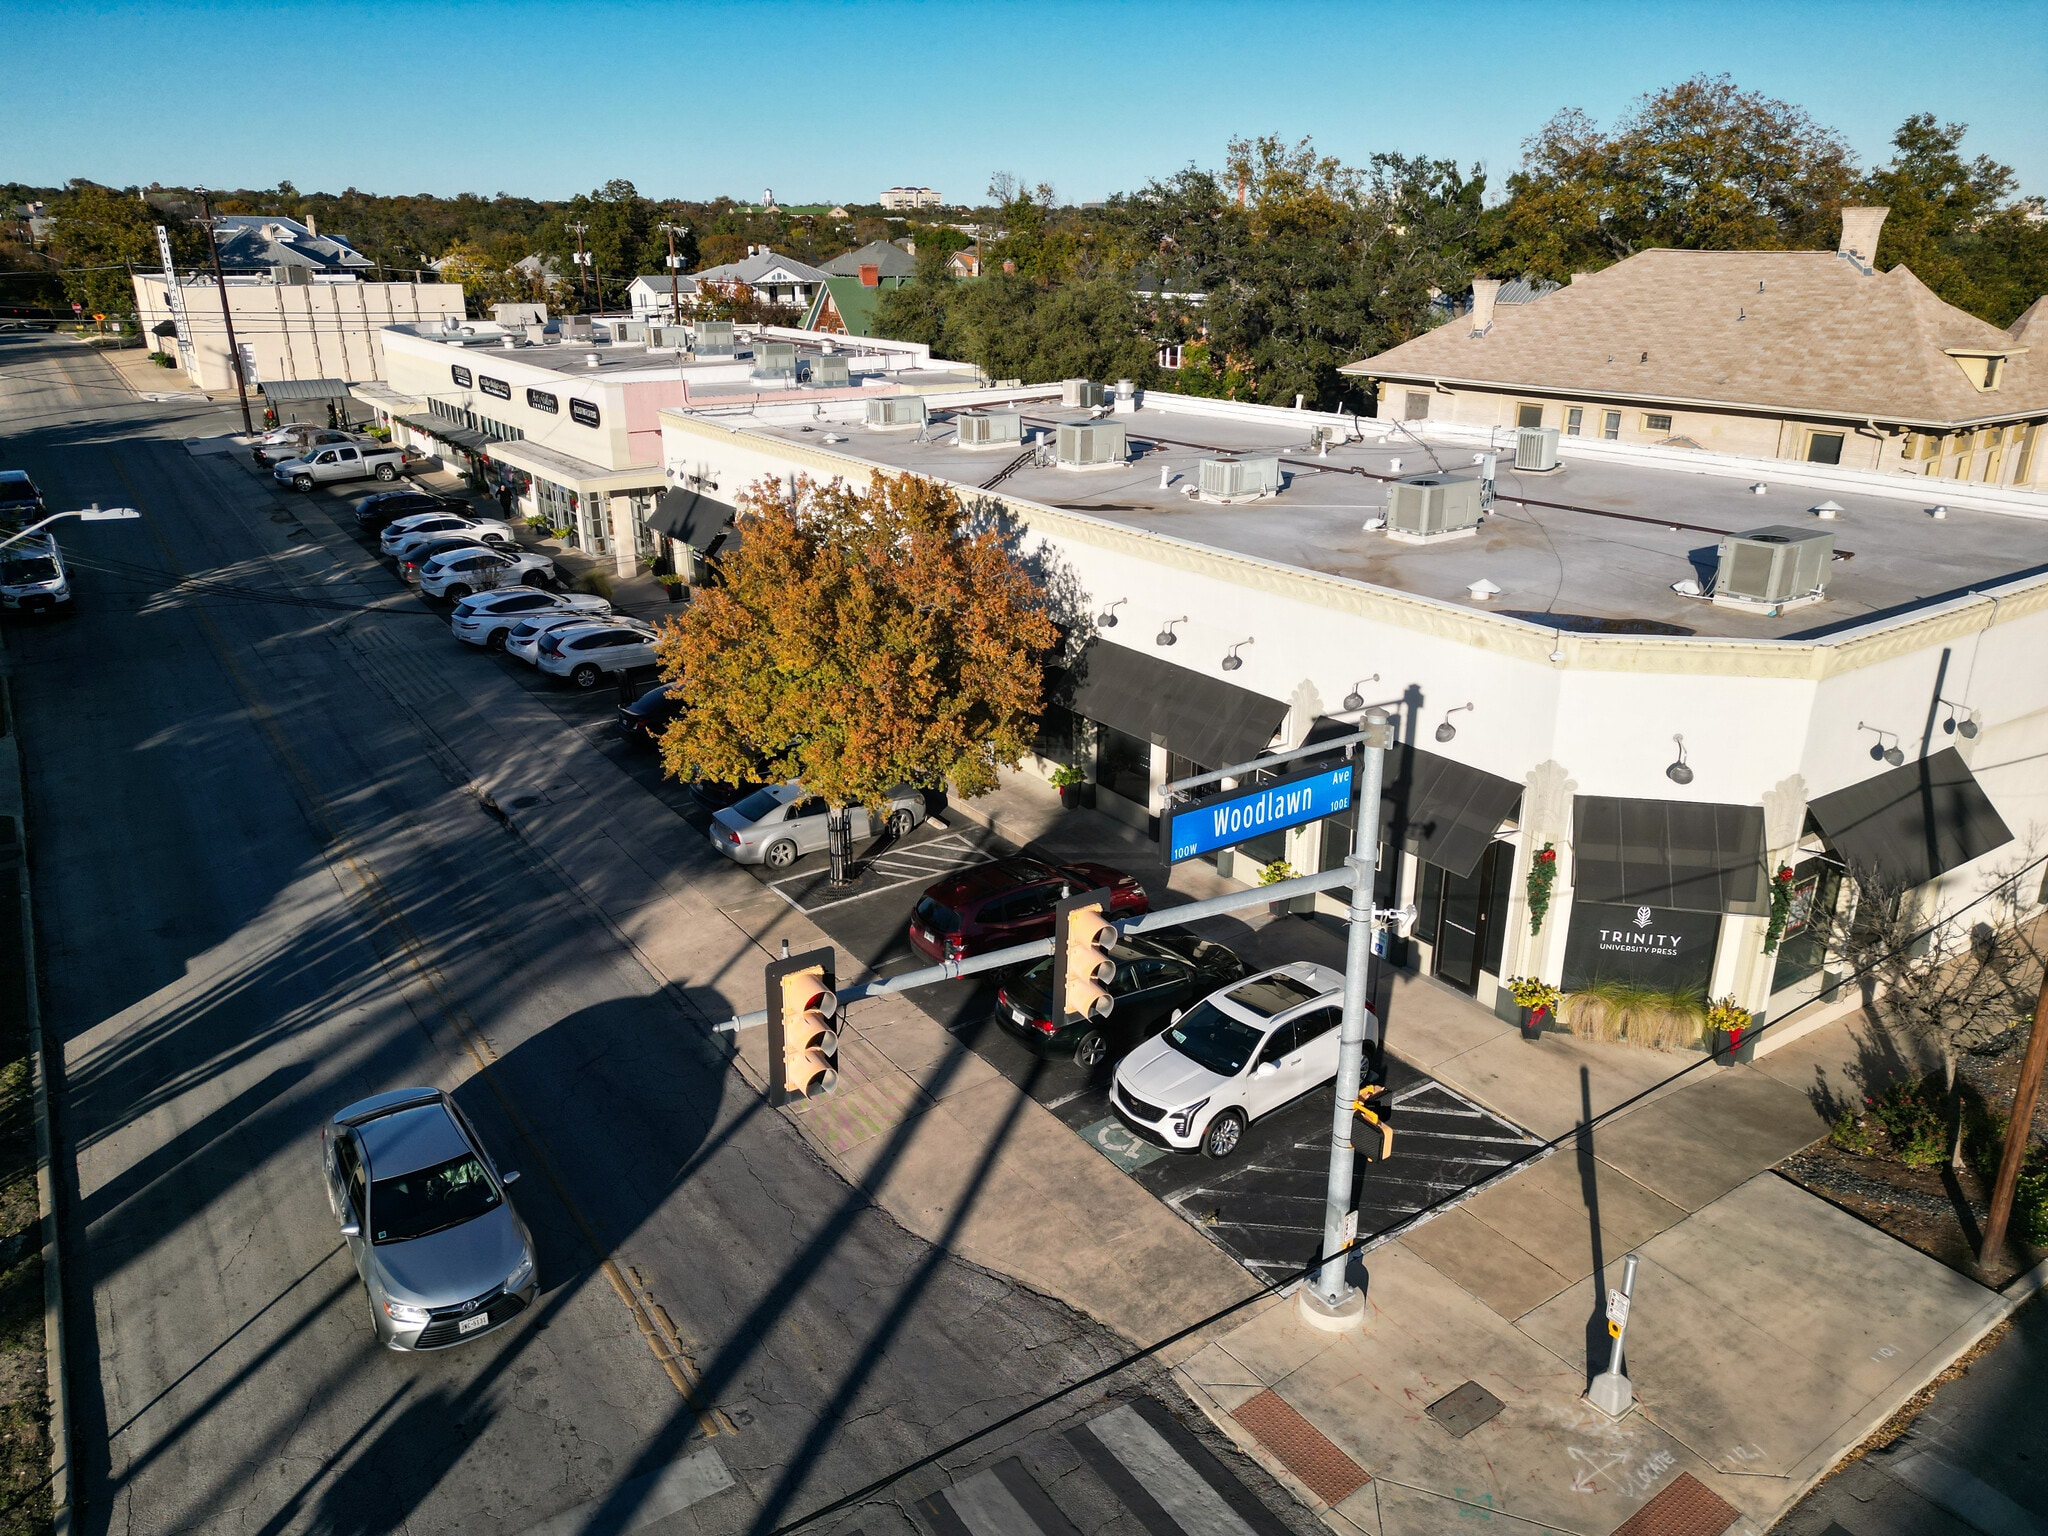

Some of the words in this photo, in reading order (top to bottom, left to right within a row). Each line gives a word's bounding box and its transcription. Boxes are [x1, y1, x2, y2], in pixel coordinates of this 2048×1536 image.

[1214, 787, 1312, 837] Woodlawn
[1332, 769, 1350, 785] Ave
[1330, 798, 1348, 811] 100E
[1174, 843, 1198, 859] 100W
[1600, 930, 1681, 947] TRINITY
[1600, 943, 1649, 953] UNIVERSITY
[1652, 947, 1677, 956] PRESS
[1633, 1449, 1677, 1490] LOCATE
